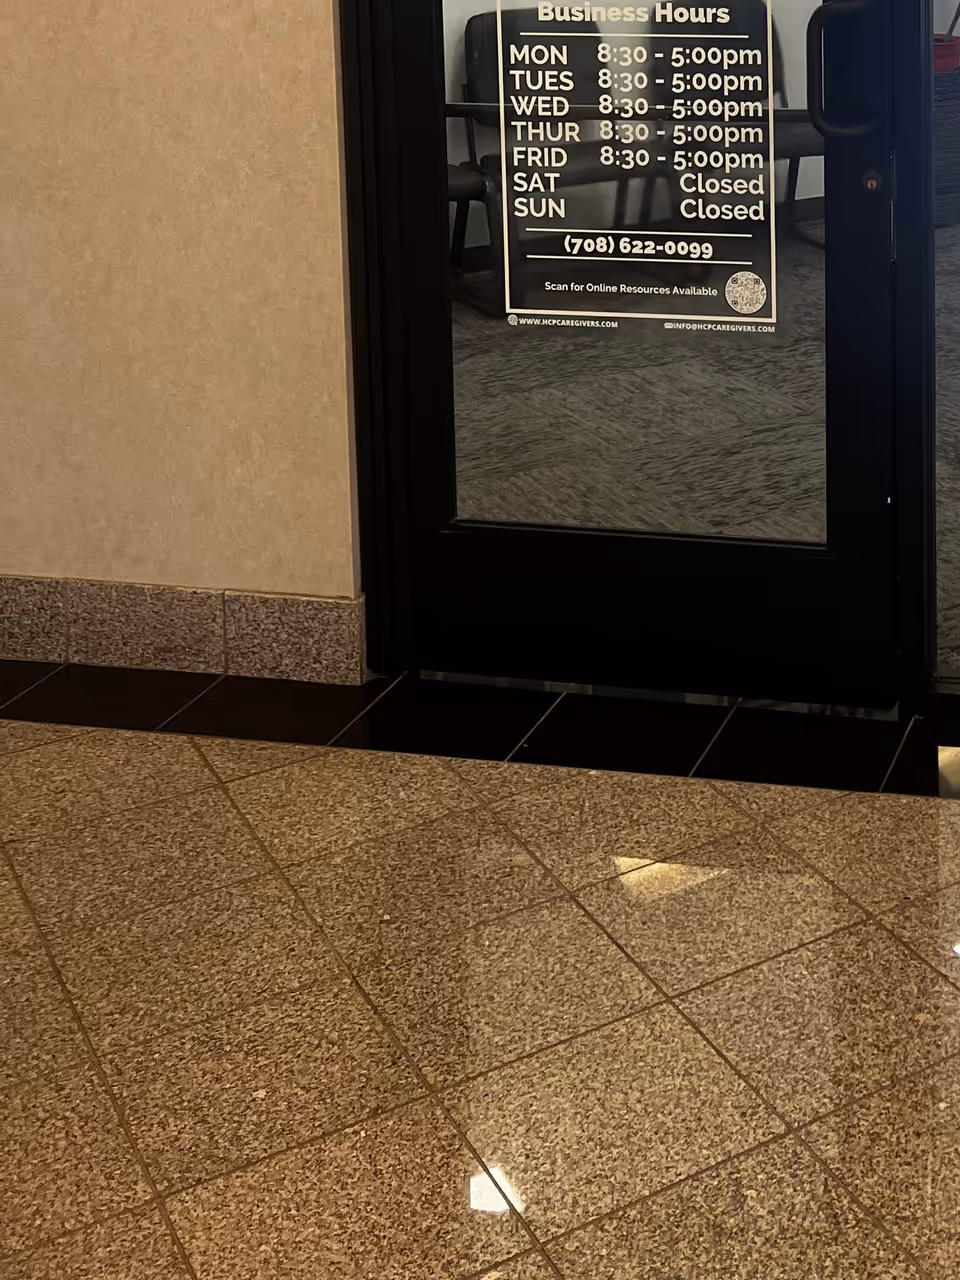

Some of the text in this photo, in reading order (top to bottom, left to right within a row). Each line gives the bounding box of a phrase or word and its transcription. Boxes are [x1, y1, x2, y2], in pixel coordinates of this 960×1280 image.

[538, 1, 730, 23] Business Hours
[510, 44, 568, 65] MON
[597, 43, 648, 66] 8:30
[671, 46, 762, 70] 5:00pm
[510, 70, 574, 91] TUES
[598, 69, 648, 93] 8:30
[672, 71, 762, 96] 5:00pm
[510, 96, 569, 116] WED
[598, 94, 649, 118] 8:30
[672, 97, 763, 121] 5:00pm
[511, 122, 580, 142] THUR
[599, 120, 649, 144] 8:30
[672, 123, 763, 147] 5:00pm
[512, 147, 568, 167] FRID
[600, 146, 650, 170] 8:30
[673, 149, 764, 173] 5:00pm
[513, 173, 765, 195] SAT Closed
[514, 198, 765, 221] SUN Closed
[564, 234, 714, 259] (708) 622-0099
[544, 282, 718, 296] Scan for Online Resources Available
[518, 318, 619, 329] WWW.HCPCAREGIVERS.COM
[673, 322, 776, 333] INFO@HCPCAREGIVERS.COM
